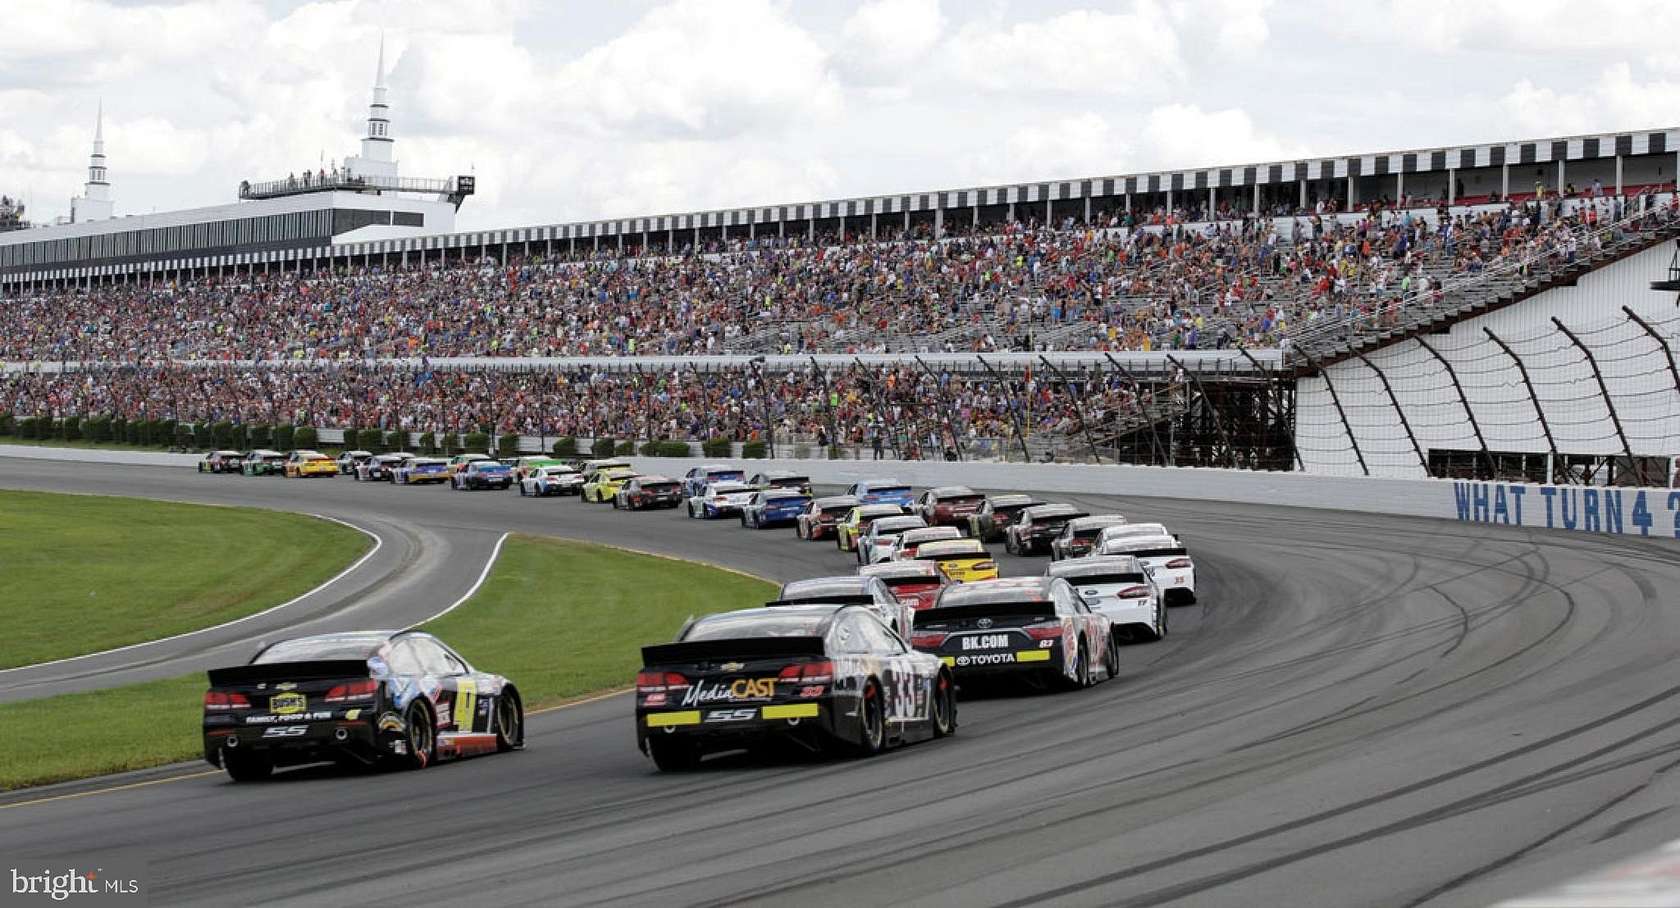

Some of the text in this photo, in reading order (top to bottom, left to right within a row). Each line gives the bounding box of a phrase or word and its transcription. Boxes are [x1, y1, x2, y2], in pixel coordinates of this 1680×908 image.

[1454, 482, 1526, 527] WHAT
[1540, 487, 1623, 534] TURN
[962, 634, 1009, 650] BK.COM
[970, 653, 1015, 665] TOYOTA
[704, 708, 758, 723] SS
[262, 724, 309, 738] SS
